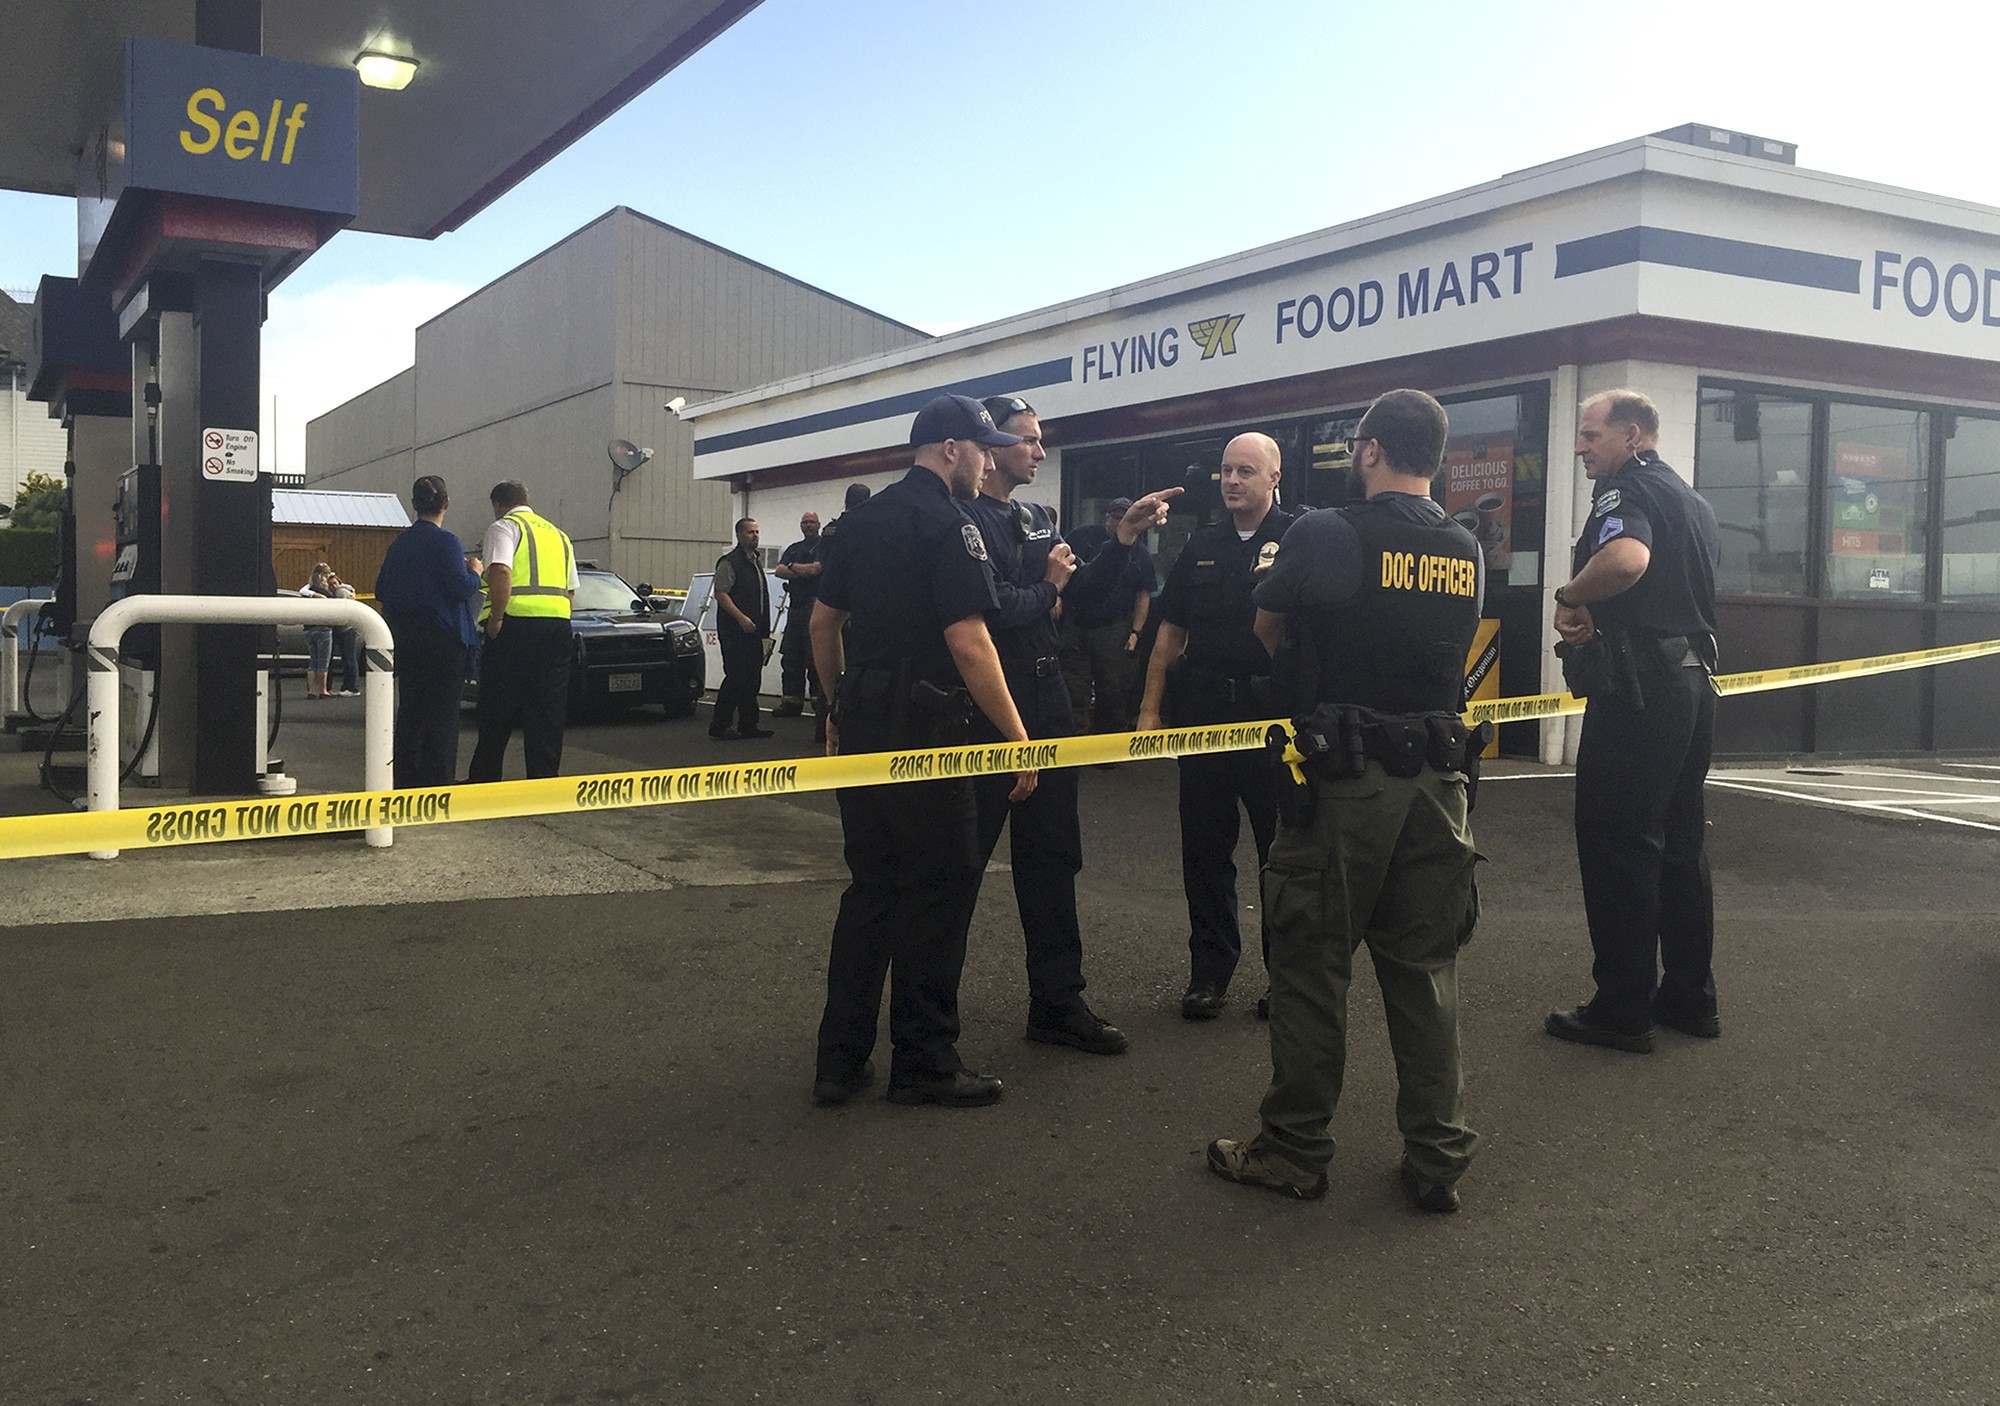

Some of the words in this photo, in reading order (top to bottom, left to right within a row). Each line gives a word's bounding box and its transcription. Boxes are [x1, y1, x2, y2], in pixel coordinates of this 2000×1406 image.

[180, 87, 309, 164] Self
[1083, 327, 1179, 384] FLYING
[1276, 280, 1384, 345] FOOD
[1397, 241, 1533, 320] MART
[226, 434, 239, 442] Turn
[243, 435, 254, 443] Off
[225, 443, 247, 451] Engine
[226, 467, 254, 477] Smoking
[1451, 460, 1507, 479] DELICIOUS
[1451, 479, 1480, 492] COFFEE
[1483, 478, 1494, 489] TO
[1382, 551, 1415, 590] DOC
[1418, 553, 1475, 597] OFFICER
[1870, 569, 1889, 578] ATM
[1467, 647, 1497, 688] Oregonian
